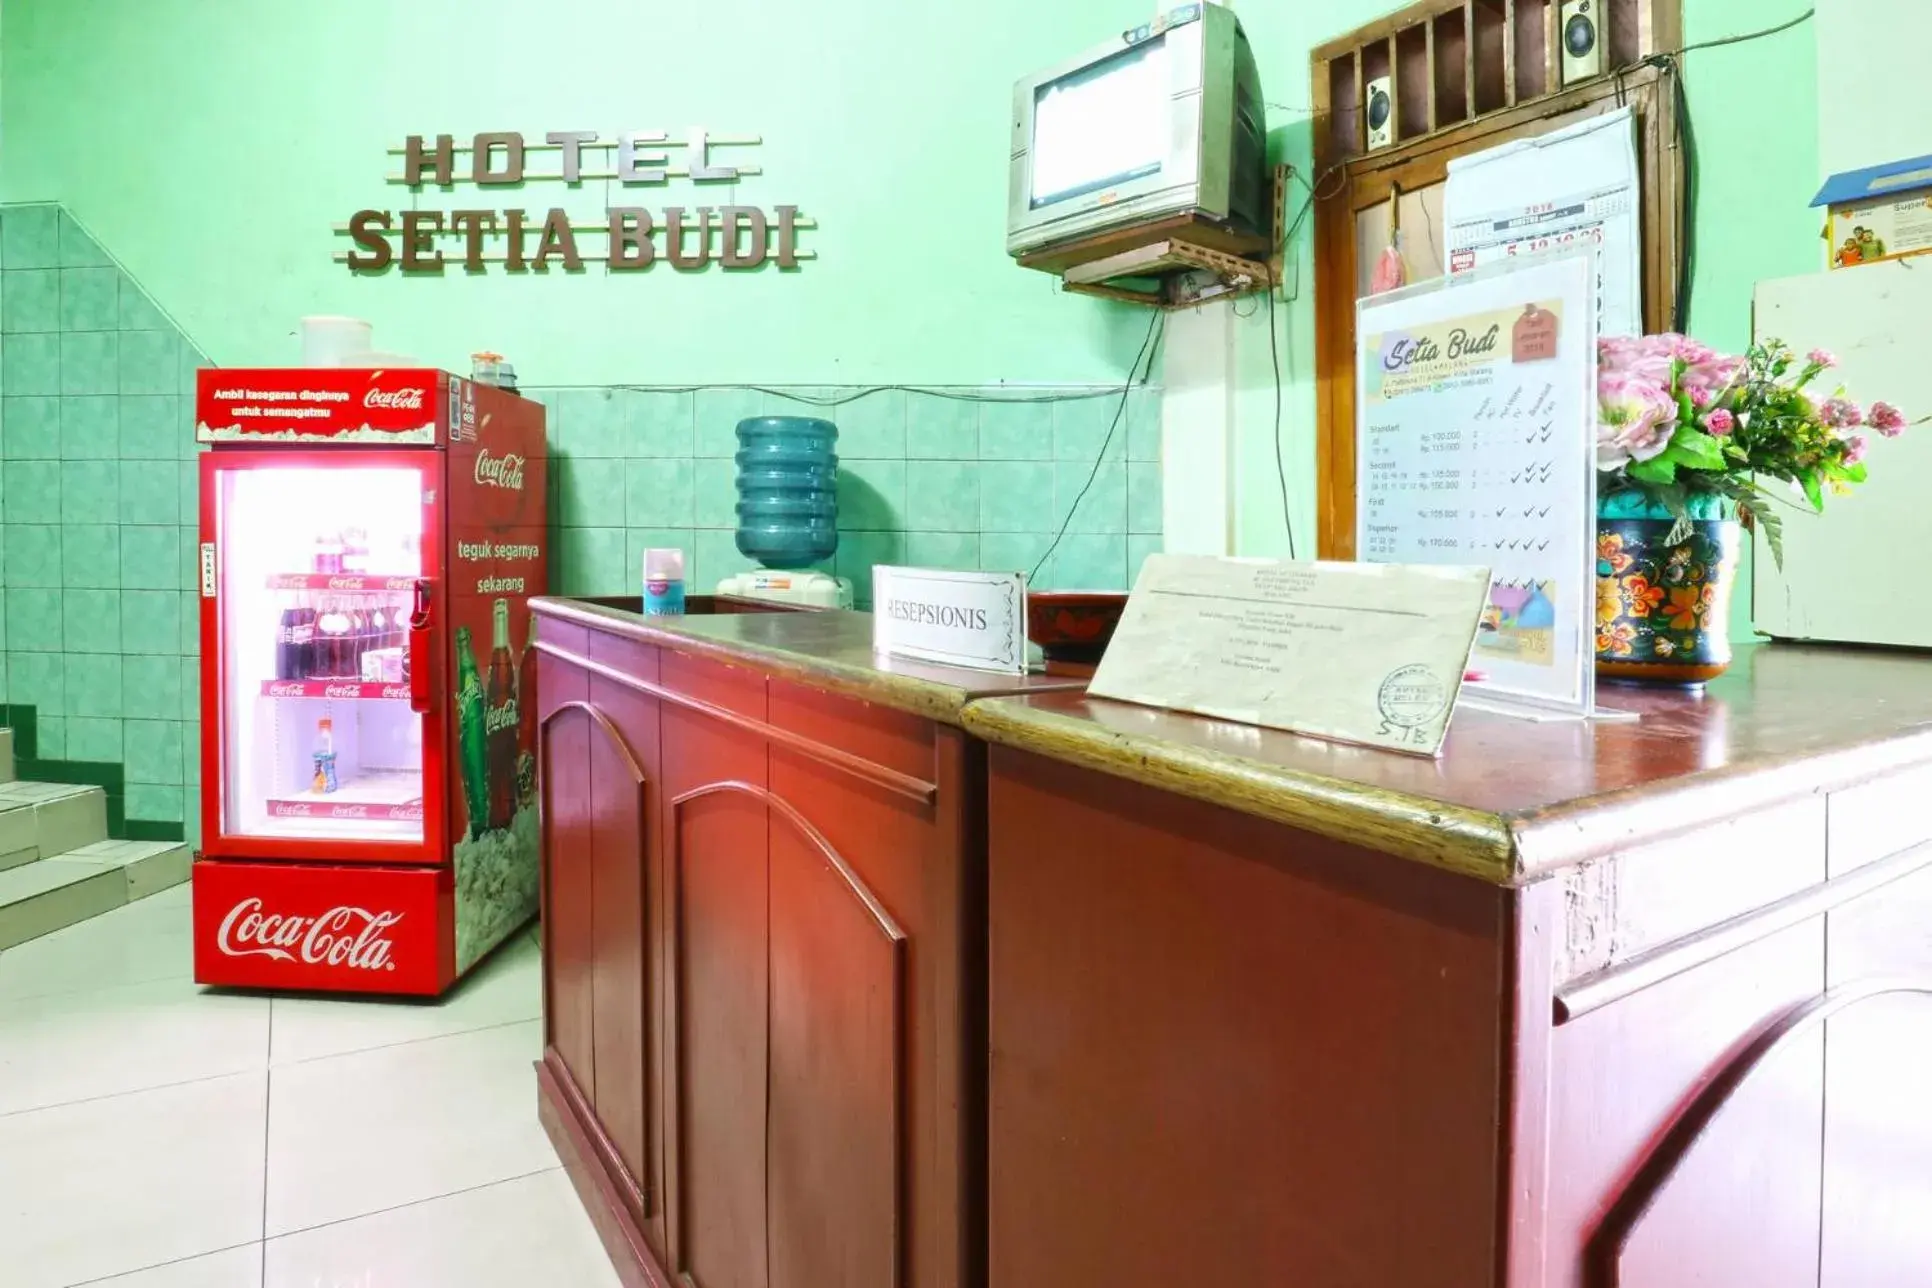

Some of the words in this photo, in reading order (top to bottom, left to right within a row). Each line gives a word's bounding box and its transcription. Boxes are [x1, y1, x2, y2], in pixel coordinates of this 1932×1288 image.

[404, 128, 738, 185] HOTEL
[347, 207, 586, 274] SETIA
[607, 205, 799, 270] BUDI
[1384, 336, 1441, 370] Setia
[1447, 324, 1500, 360] Budi
[214, 388, 244, 401] Ambil
[363, 387, 426, 410] Coca-Cola
[231, 406, 262, 417] untuk
[474, 448, 525, 491] Coca-Cola
[458, 540, 492, 561] teguk
[494, 543, 540, 561] segarnya
[477, 575, 525, 594] sekarang
[888, 599, 987, 631] RESEPSIONIS
[217, 897, 405, 972] Coca-Cola
